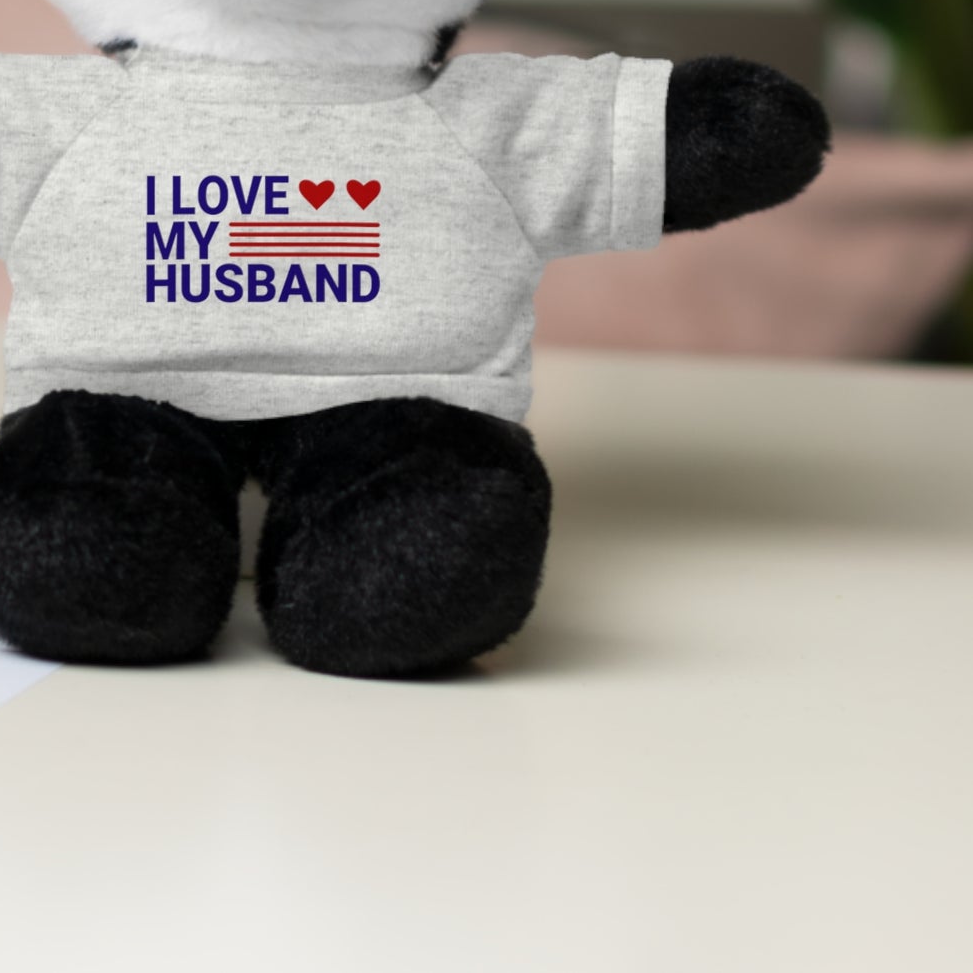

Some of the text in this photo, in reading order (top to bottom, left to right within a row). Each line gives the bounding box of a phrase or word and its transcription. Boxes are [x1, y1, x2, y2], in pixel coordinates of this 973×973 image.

[146, 175, 290, 215] I LOVE
[146, 221, 219, 260] MY
[146, 264, 381, 303] HUSBAND
